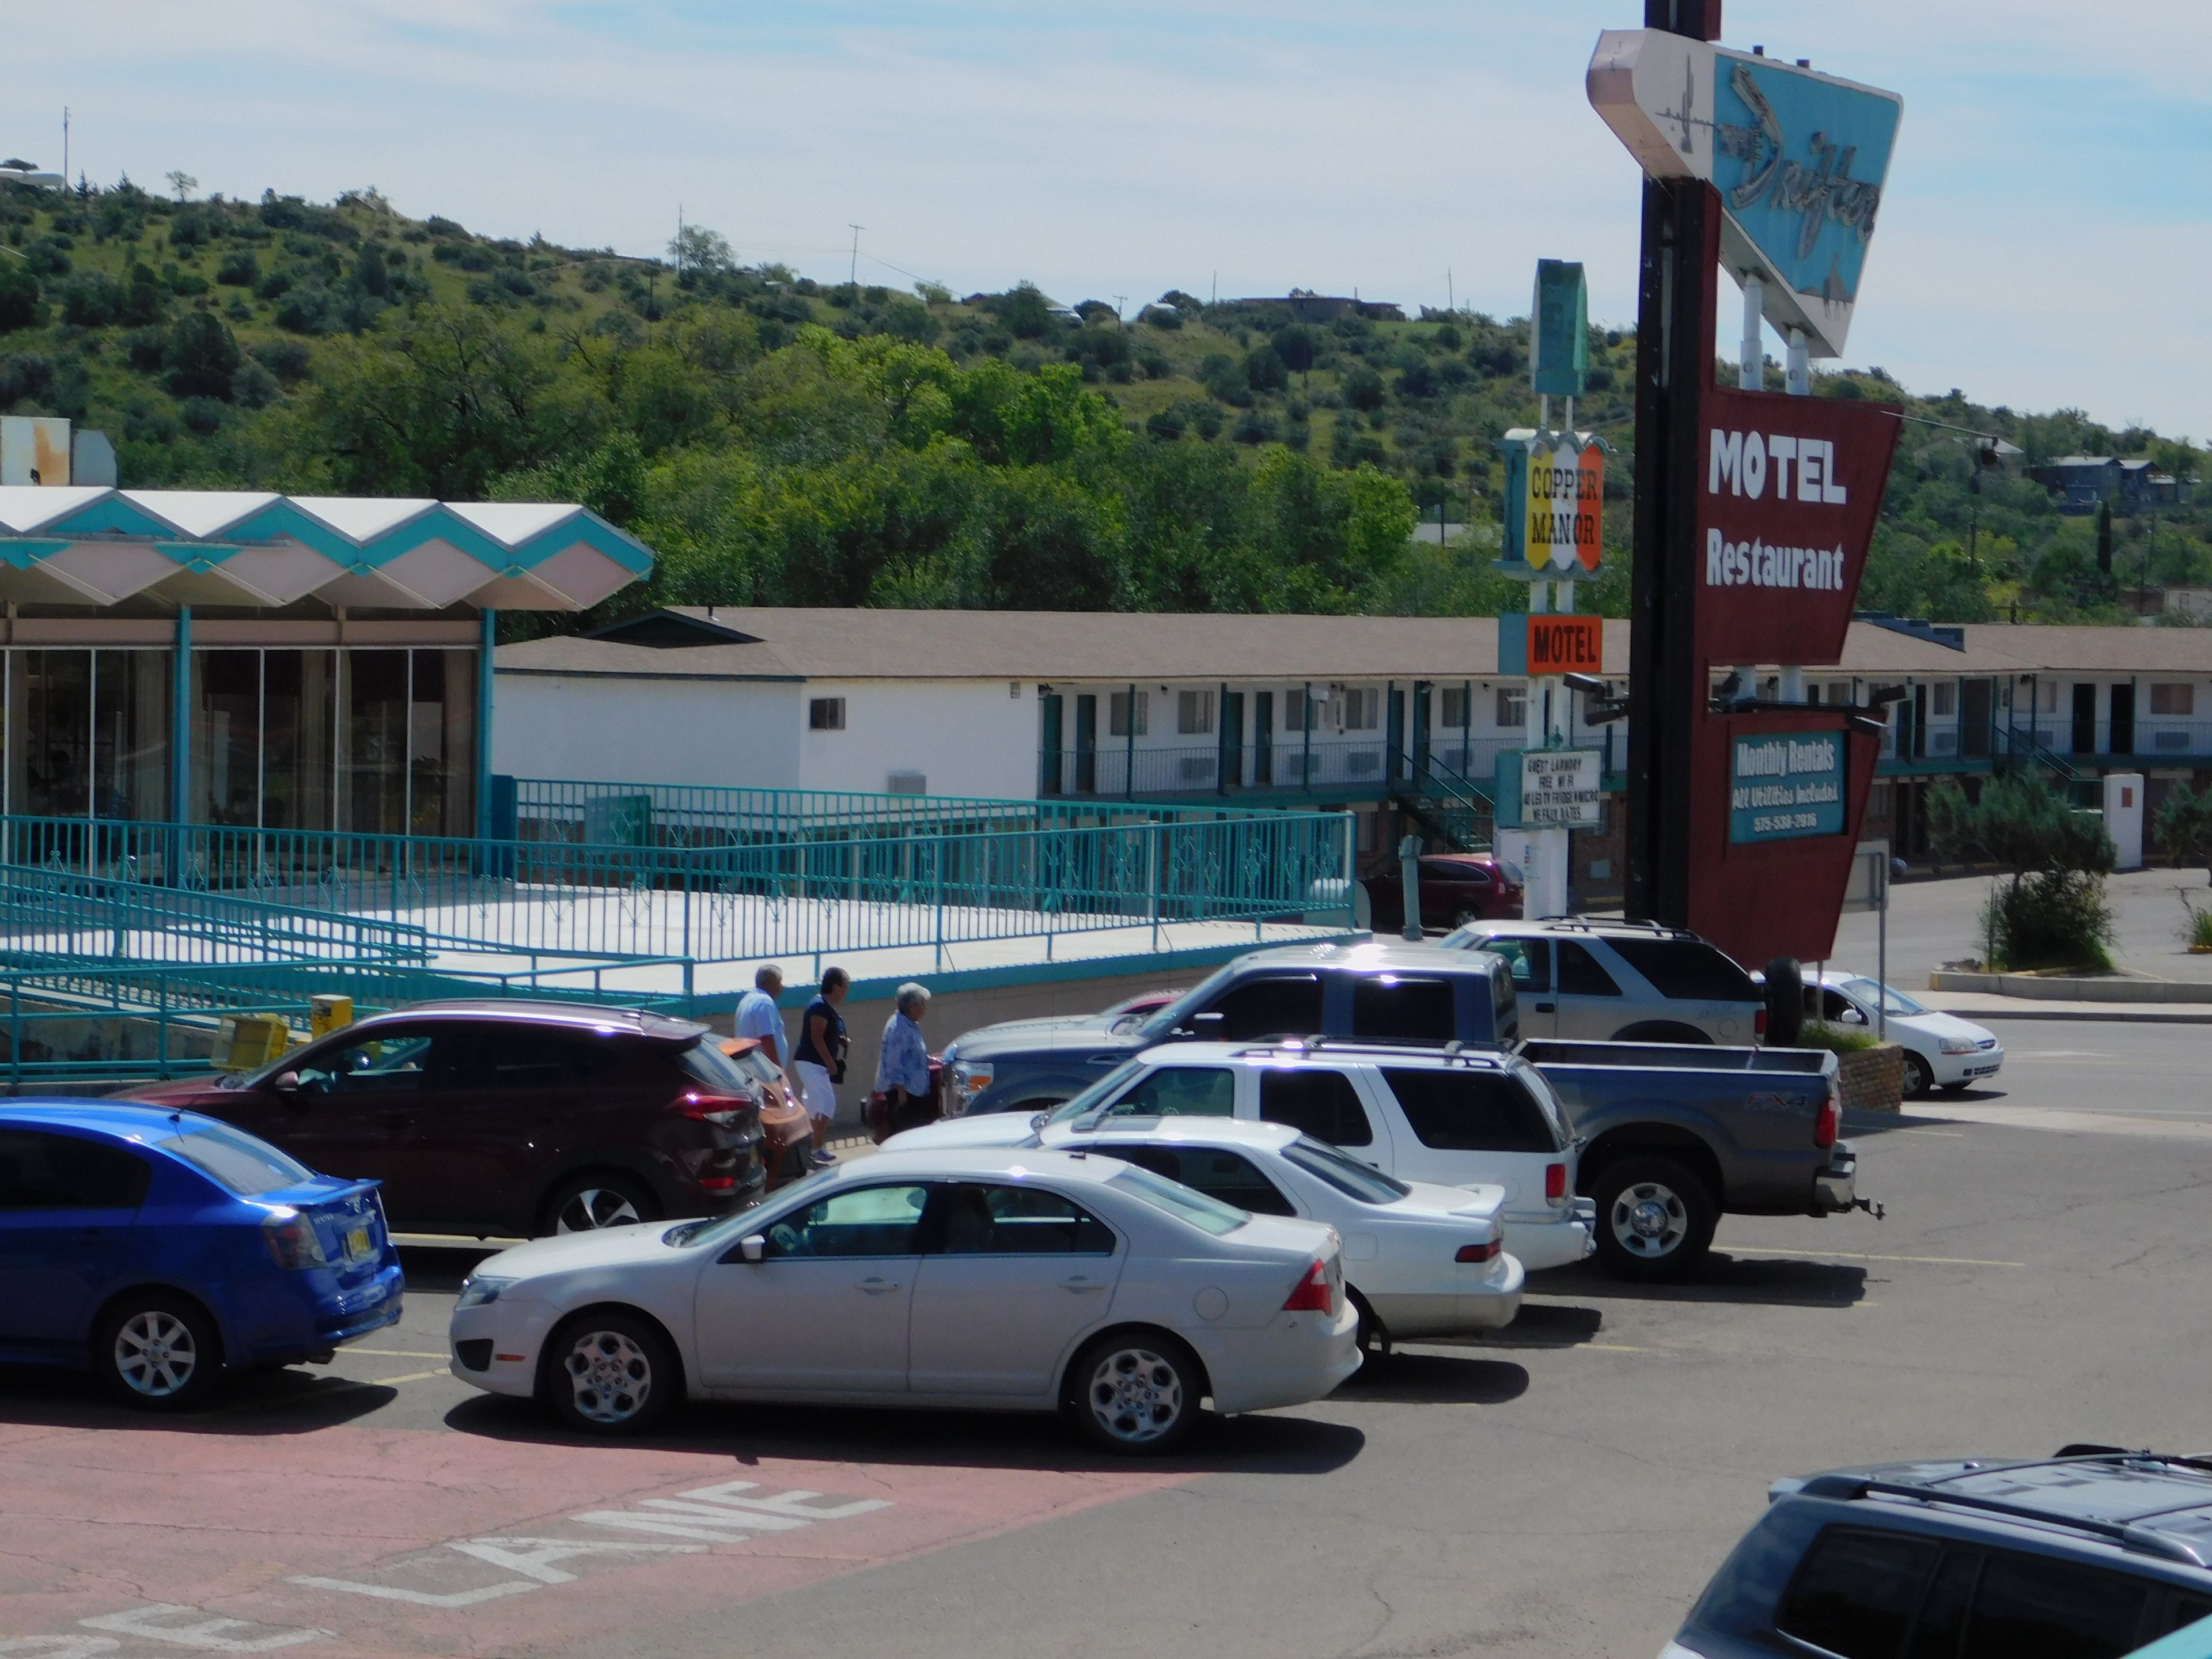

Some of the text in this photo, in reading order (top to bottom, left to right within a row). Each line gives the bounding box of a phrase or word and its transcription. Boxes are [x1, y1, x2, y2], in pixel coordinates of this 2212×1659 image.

[1532, 466, 1598, 500] COPPER
[1709, 429, 1847, 505] MOTEL
[1532, 512, 1595, 545] MANOR
[1706, 528, 1844, 591] Restaurant
[1533, 625, 1597, 664] MOTEL
[1737, 738, 1835, 778] Monthly Rentals
[281, 1480, 900, 1608] LANE
